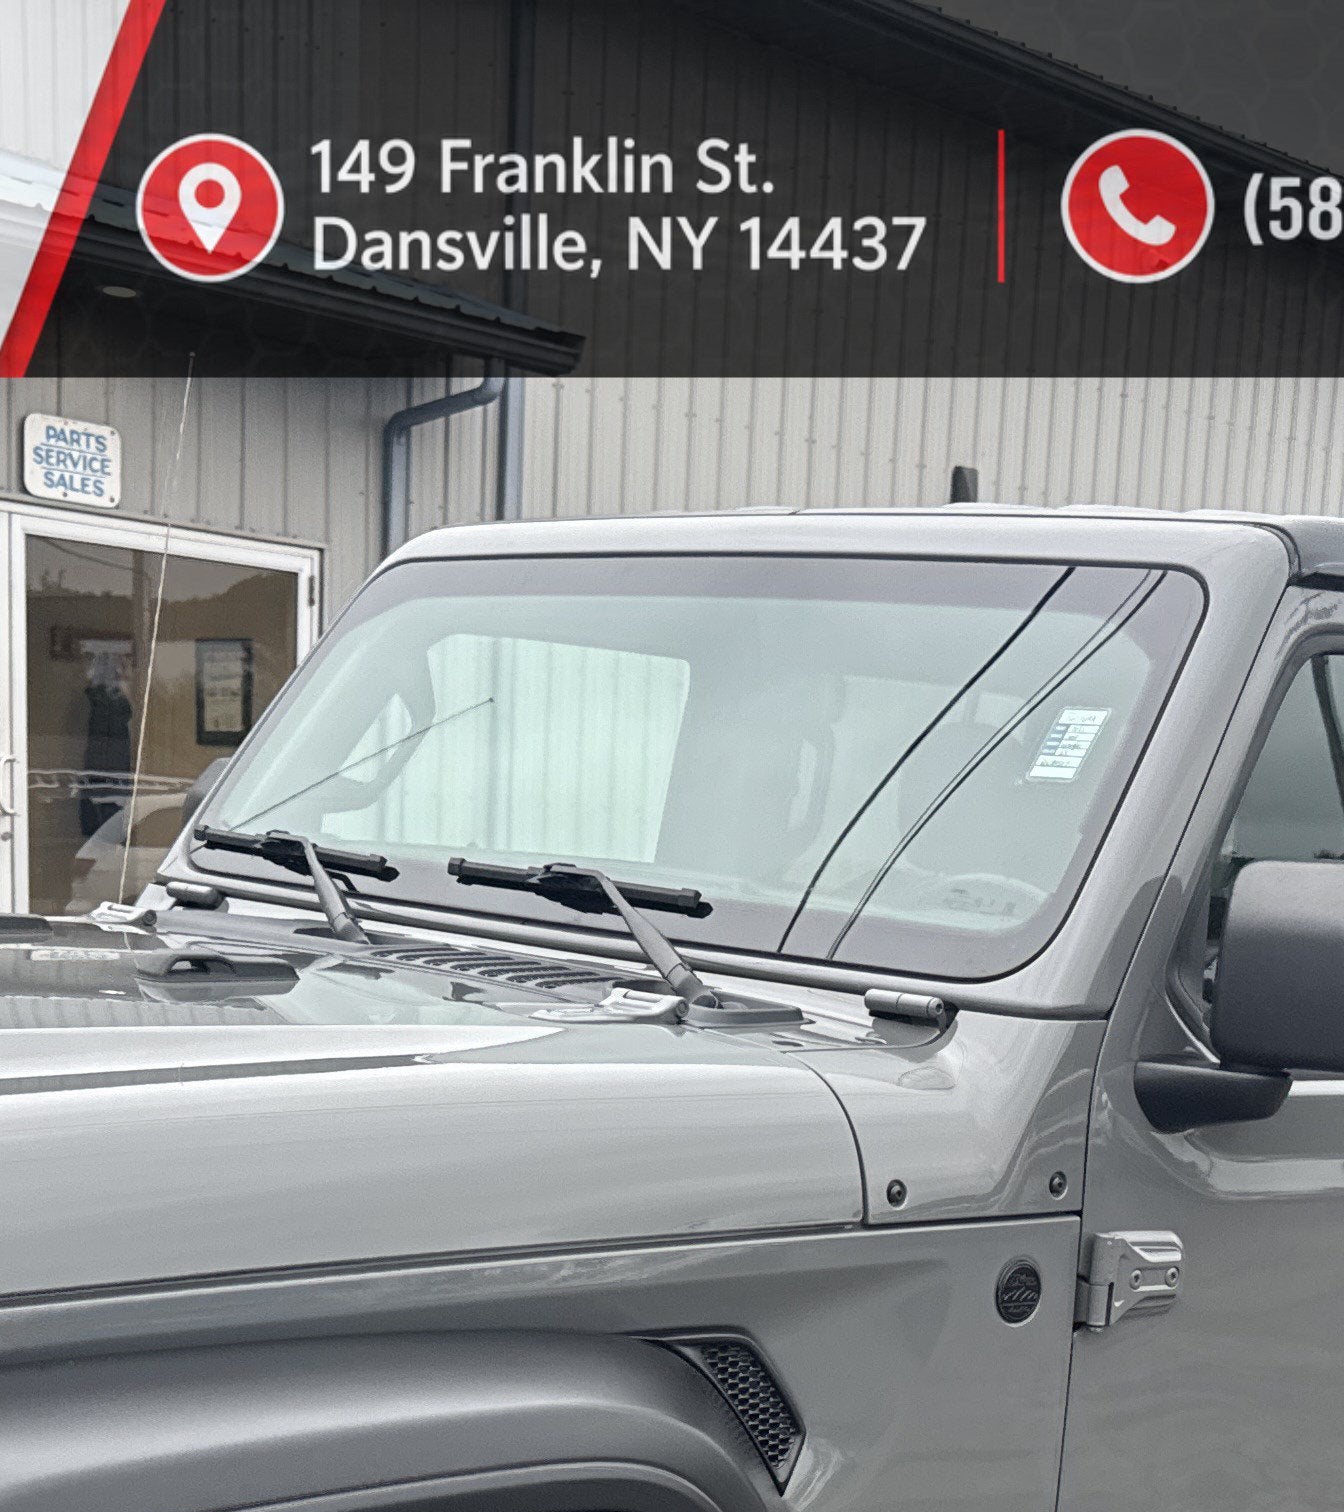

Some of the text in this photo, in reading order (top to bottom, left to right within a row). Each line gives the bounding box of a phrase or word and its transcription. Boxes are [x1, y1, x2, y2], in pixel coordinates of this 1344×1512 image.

[45, 425, 107, 453] PARTS
[33, 446, 112, 477] SERVICE
[43, 471, 104, 497] SALES
